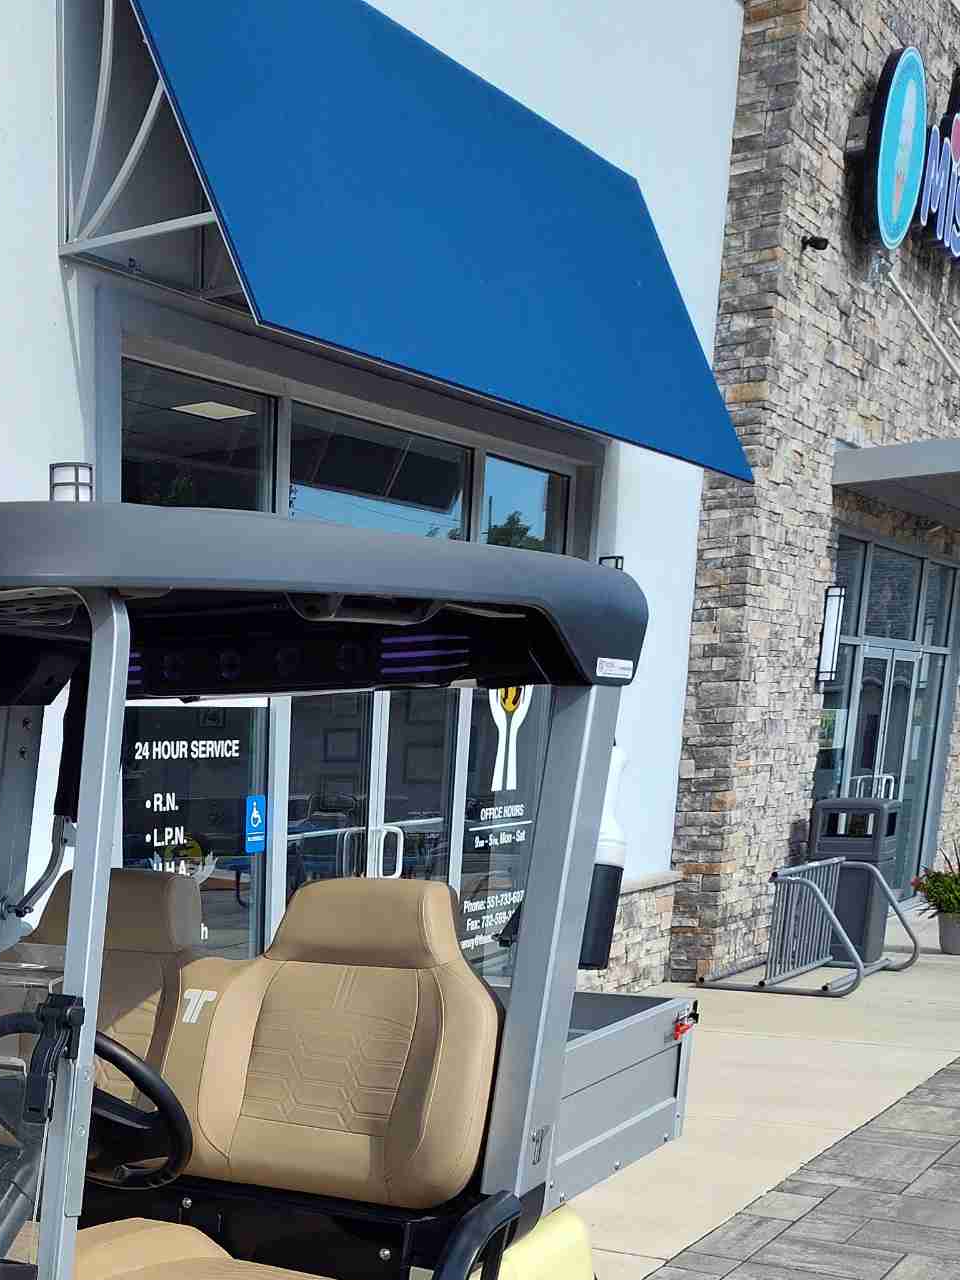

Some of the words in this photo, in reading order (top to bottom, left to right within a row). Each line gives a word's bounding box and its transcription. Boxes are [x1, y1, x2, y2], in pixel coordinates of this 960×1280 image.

[920, 113, 960, 257] Mi
[134, 742, 150, 760] 24
[152, 740, 188, 760] HOUR
[190, 739, 240, 759] SERVICE
[153, 792, 179, 812] R.N.
[480, 806, 503, 821] OFFICE
[503, 804, 525, 818] HOURS
[153, 826, 187, 847] L.P.N.
[463, 900, 486, 914] Phone:
